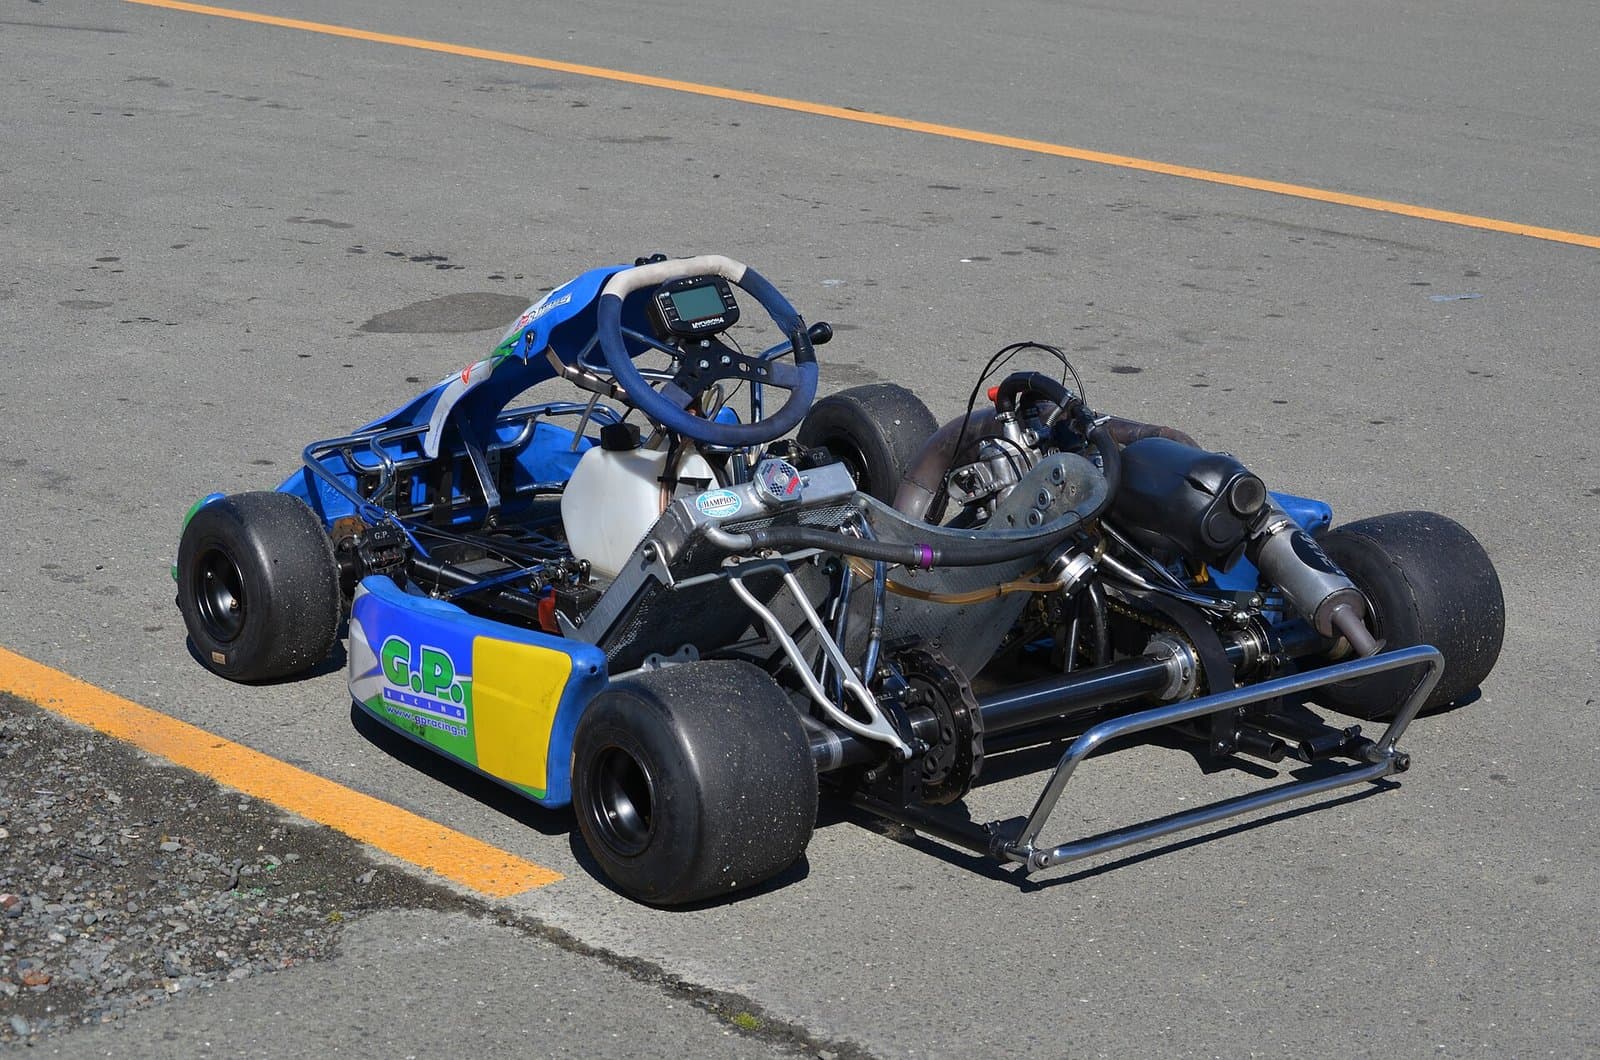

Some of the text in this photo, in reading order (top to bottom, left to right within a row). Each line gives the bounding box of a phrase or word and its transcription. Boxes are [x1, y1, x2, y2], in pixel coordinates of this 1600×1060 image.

[699, 495, 738, 508] CHAMPION
[375, 530, 390, 540] G.P.
[380, 635, 464, 704] G.P.
[387, 691, 462, 717] RACING
[386, 705, 468, 737] www.gpracing.it
